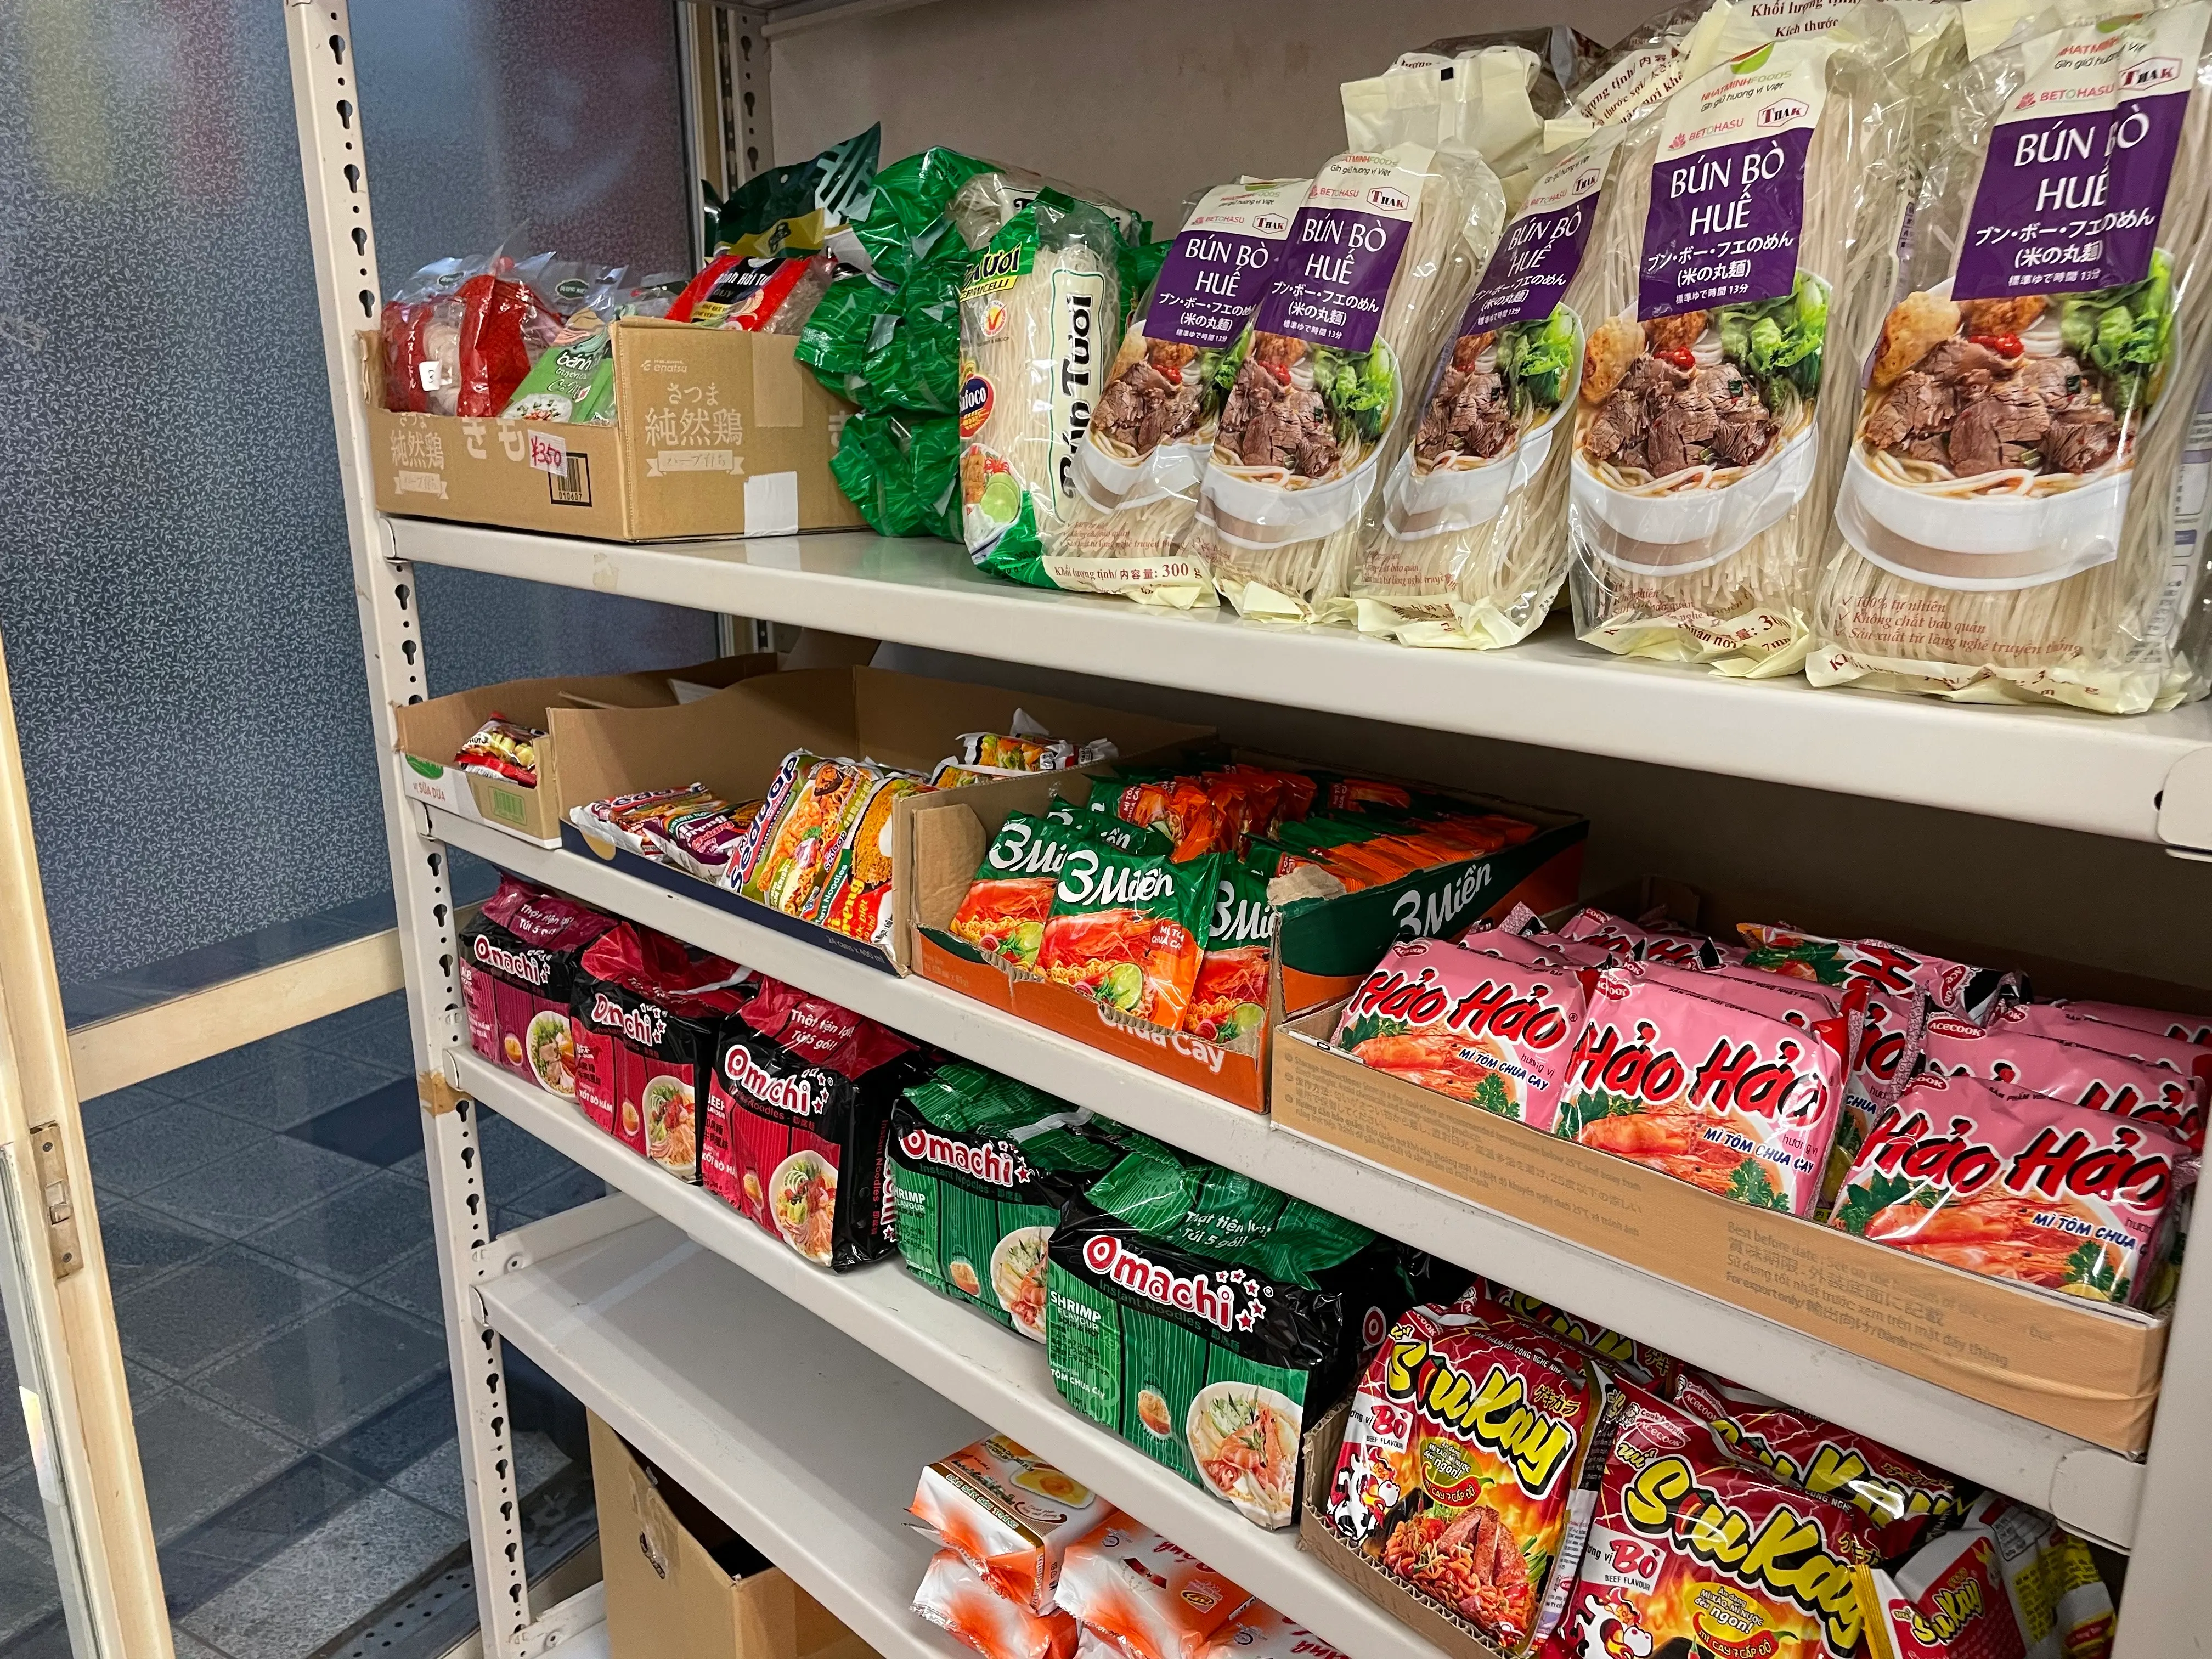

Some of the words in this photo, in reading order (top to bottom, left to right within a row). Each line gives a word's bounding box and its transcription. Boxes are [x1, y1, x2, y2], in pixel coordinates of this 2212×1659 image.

[1701, 71, 1792, 101] NHATMINHFOODS
[2040, 82, 2114, 103] BETOHASU
[1689, 118, 1744, 142] BETOHASU
[1762, 106, 1803, 124] THAK
[2014, 120, 2096, 167] BÚN
[1670, 154, 1731, 198] BÚN
[1741, 140, 1785, 185] BÒ
[1319, 188, 1359, 198] BETOHASU
[1372, 190, 1404, 208] THAK
[1530, 189, 1567, 206] BETOHASU
[1689, 184, 1753, 236] HUẾ
[1302, 213, 1344, 244] BÚN
[1348, 220, 1386, 252] BÒ
[1508, 217, 1551, 251] BÚN
[1550, 204, 1582, 239] BÒ
[1185, 234, 1231, 263] BÚN
[1235, 242, 1268, 268] BÒ
[1305, 249, 1356, 284] HUẾ
[1507, 239, 1556, 278] HUẾ
[1647, 230, 1793, 272] ブン・ボー・フエのめん
[1195, 266, 1242, 297] HUẾ
[1729, 284, 1749, 295] 13分
[1062, 293, 1093, 389] Tươi
[654, 364, 687, 373] enatsu
[667, 382, 719, 406] さつま
[645, 408, 743, 447] 純然鶏
[531, 436, 562, 467] ¥350
[558, 492, 582, 501] 010607
[1162, 563, 1189, 577] 300
[1193, 568, 1203, 579] g
[1852, 612, 1891, 629] Không
[1908, 601, 1946, 612] nhiên
[1928, 633, 1956, 649] làng
[730, 756, 798, 893] Sedaap
[988, 822, 1031, 870] 3
[826, 864, 848, 901] Noodles
[1057, 850, 1099, 904] 3
[1092, 868, 1175, 906] Miền
[1393, 889, 1421, 935] 3
[1425, 860, 1492, 937] Miền
[474, 934, 540, 985] Omachi
[1350, 966, 1448, 1024] Hảo
[1447, 981, 1566, 1049] Hảo
[1172, 1035, 1226, 1074] Cay
[1459, 1048, 1475, 1060] MÌ
[1475, 1054, 1498, 1070] TÔM
[1498, 1062, 1527, 1081] CHUA
[1527, 1073, 1550, 1091] CAY
[1565, 1022, 1685, 1102] Hảo
[1689, 1039, 1827, 1127] Hảo
[1846, 1095, 1877, 1114] CHUA
[901, 1130, 1013, 1186] Omachi
[1704, 1126, 1723, 1141] MÌ
[1724, 1134, 1753, 1152] TÔM
[1755, 1146, 1790, 1166] CHUA
[1794, 1158, 1814, 1173] CAY
[1854, 1104, 2000, 1194] Hảo
[2005, 1127, 2171, 1212] Hảo
[920, 1164, 953, 1181] Instant
[1182, 1226, 1204, 1242] Túi
[1204, 1232, 1215, 1244] 5
[1216, 1234, 1247, 1249] gói!
[2032, 1211, 2055, 1226] MÌ
[2058, 1216, 2091, 1235] TÔM
[2095, 1227, 2135, 1248] CHUA
[1084, 1235, 1233, 1331] Omachi
[1051, 1290, 1101, 1322] SHRIMP
[1058, 1306, 1098, 1331] FLAVOUR
[1099, 1278, 1144, 1306] Instant
[1147, 1300, 1202, 1331] Noodles
[1514, 1346, 1531, 1358] CÔNG
[1050, 1368, 1068, 1382] TÔM
[1069, 1376, 1090, 1392] CHUA
[1535, 1385, 1581, 1417] ゲキカラ
[1372, 1406, 1404, 1438] Bò
[1366, 1435, 1379, 1444] BEEF
[1381, 1438, 1403, 1450] FLAVOUR
[1434, 1458, 1462, 1479] ngon!
[1603, 1551, 1612, 1564] vị
[1611, 1539, 1658, 1579] Bò
[1605, 1574, 1621, 1584] BEEF
[1623, 1577, 1650, 1592] FLAVOUR
[1710, 1607, 1753, 1634] ngon!
[1712, 1641, 1730, 1656] CAY
[1733, 1649, 1739, 1657] 7
[1740, 1646, 1756, 1658] CẤP
